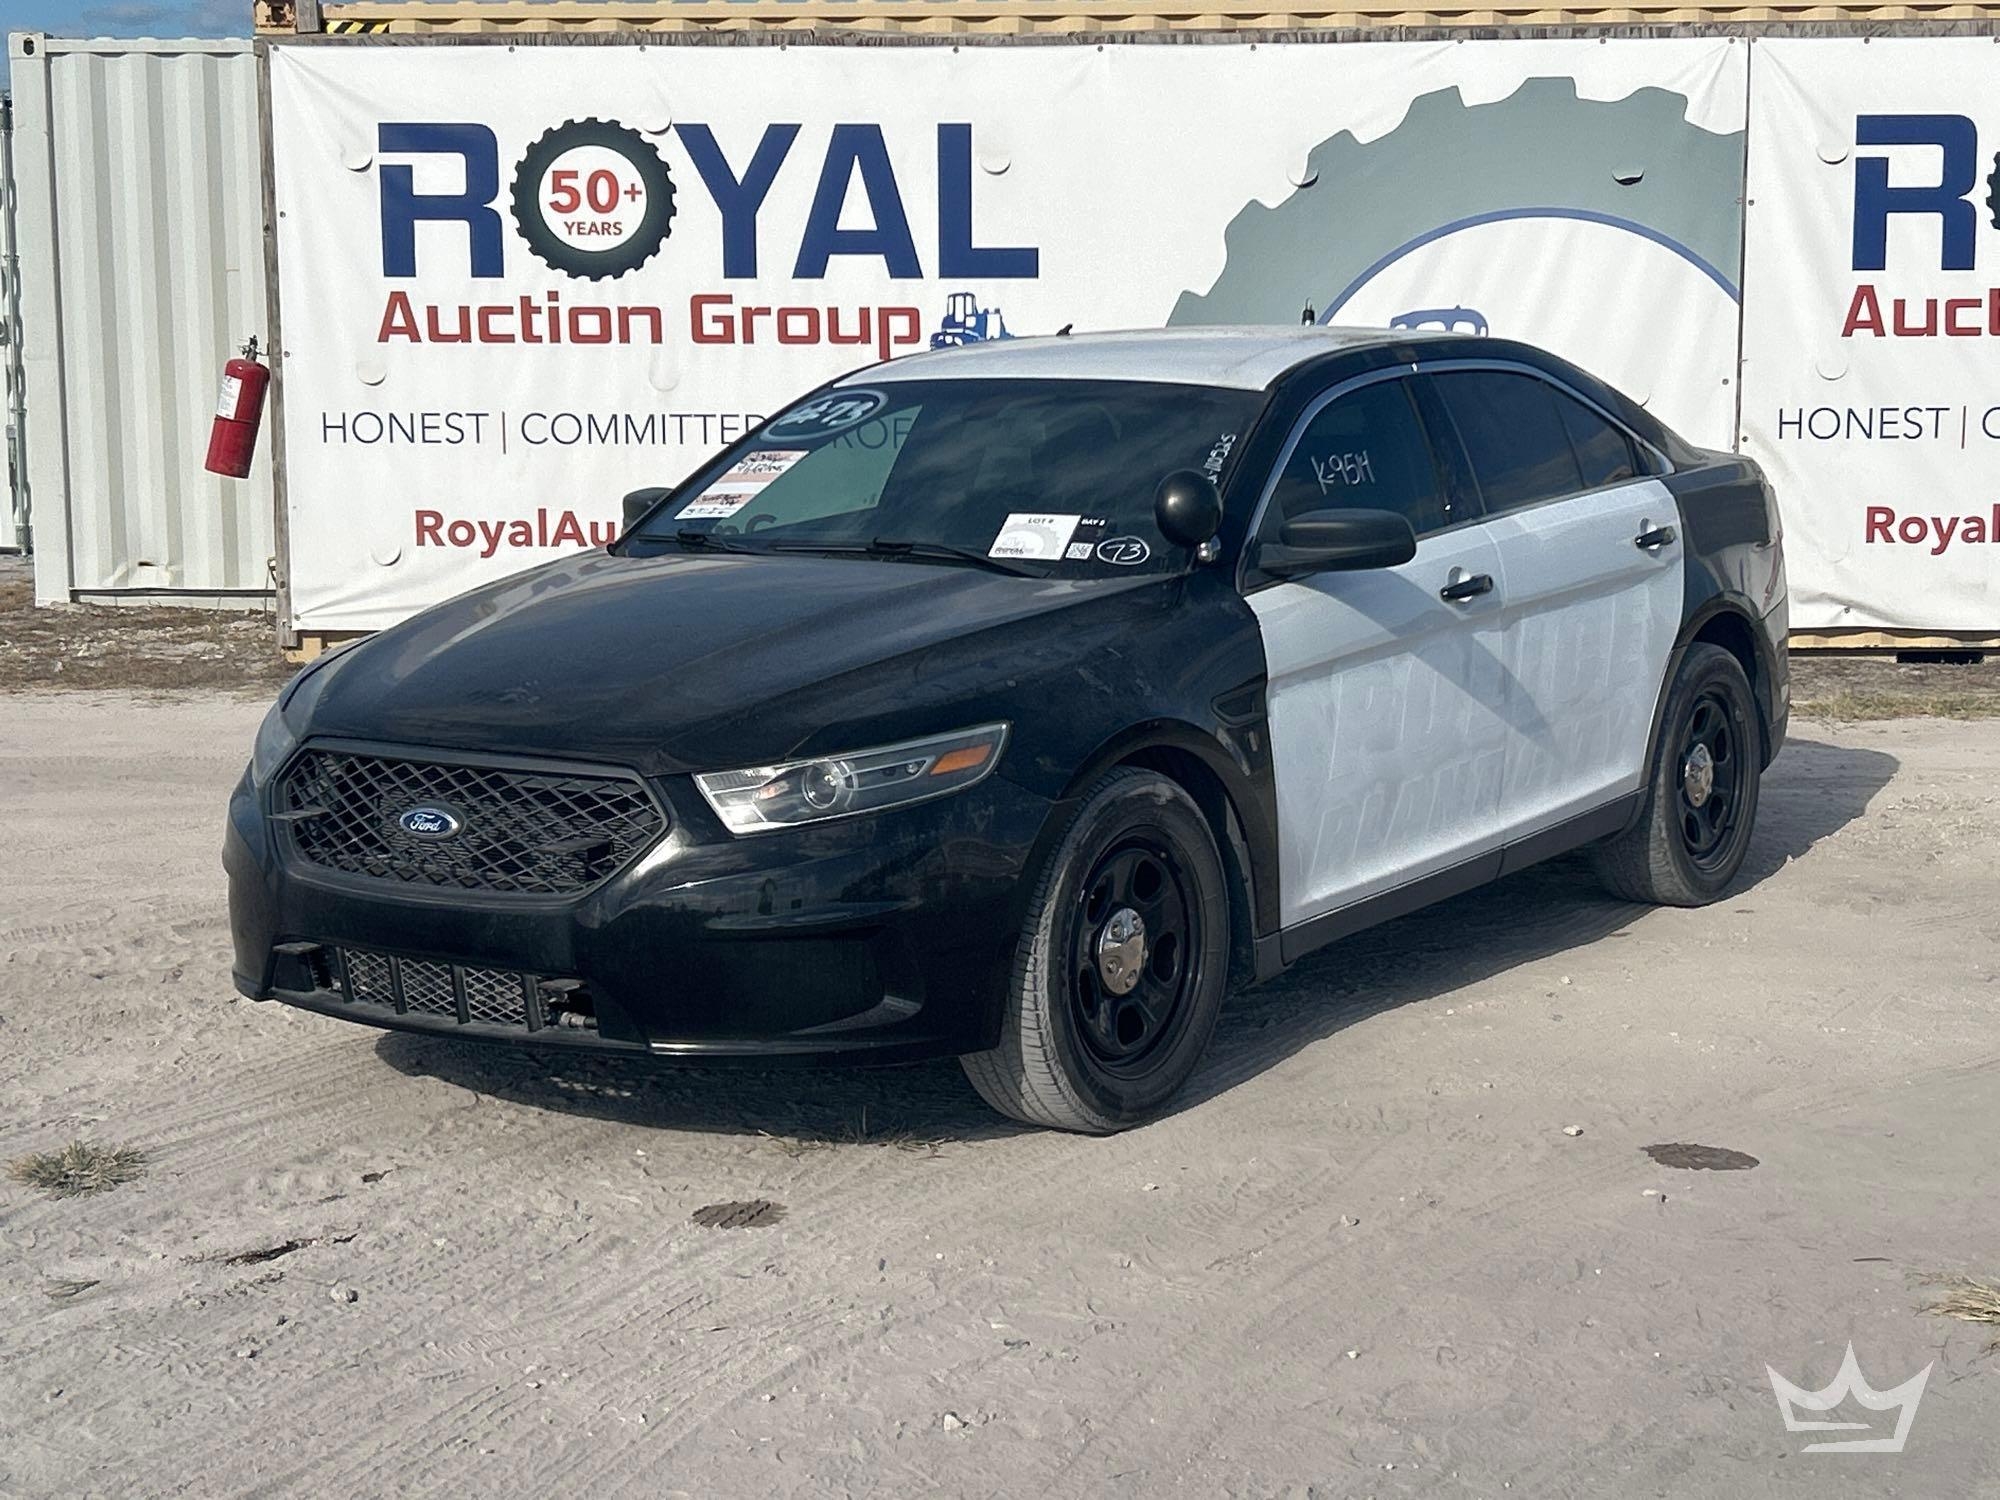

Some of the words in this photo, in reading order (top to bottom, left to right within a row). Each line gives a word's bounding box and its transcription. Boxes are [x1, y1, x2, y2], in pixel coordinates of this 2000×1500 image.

[548, 169, 643, 214] 50+
[1852, 114, 2000, 271] R
[563, 220, 623, 237] YEARS
[377, 290, 663, 344] Auction
[690, 293, 921, 361] Group
[322, 411, 490, 445] HONEST
[1778, 406, 1951, 440] HONEST
[1028, 517, 1047, 525] LOT
[1865, 502, 2000, 556] Royal
[1106, 543, 1141, 563] 73
[409, 813, 442, 832] Ford
